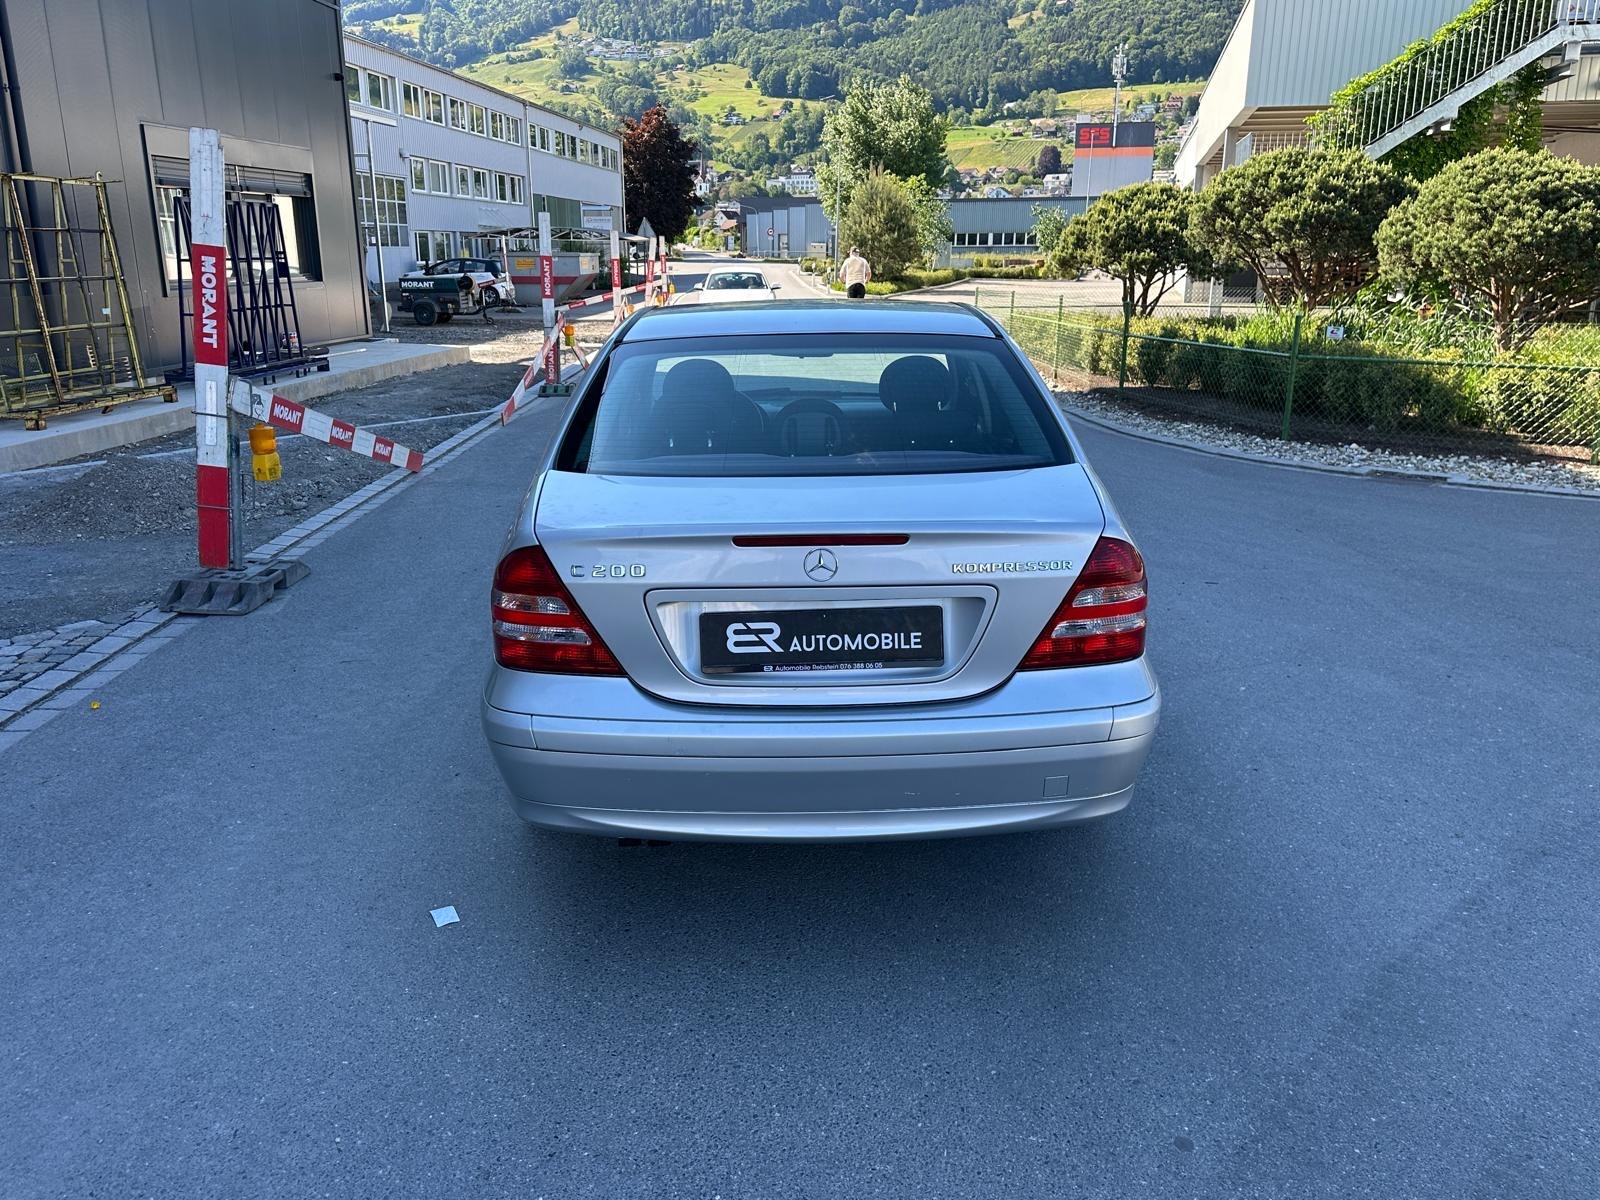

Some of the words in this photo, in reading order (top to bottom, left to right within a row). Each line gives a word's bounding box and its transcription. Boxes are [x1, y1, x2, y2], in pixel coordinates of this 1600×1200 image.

[1079, 127, 1110, 145] SFS
[543, 259, 551, 296] MORANT
[201, 255, 218, 349] MORANT
[273, 402, 302, 425] MORANT
[331, 425, 353, 442] MORANT
[374, 442, 392, 457] MORANT
[570, 564, 585, 578] C
[591, 564, 647, 578] 200
[952, 560, 1074, 573] KOMPRESSOR
[789, 632, 923, 652] AUTOMOBILE
